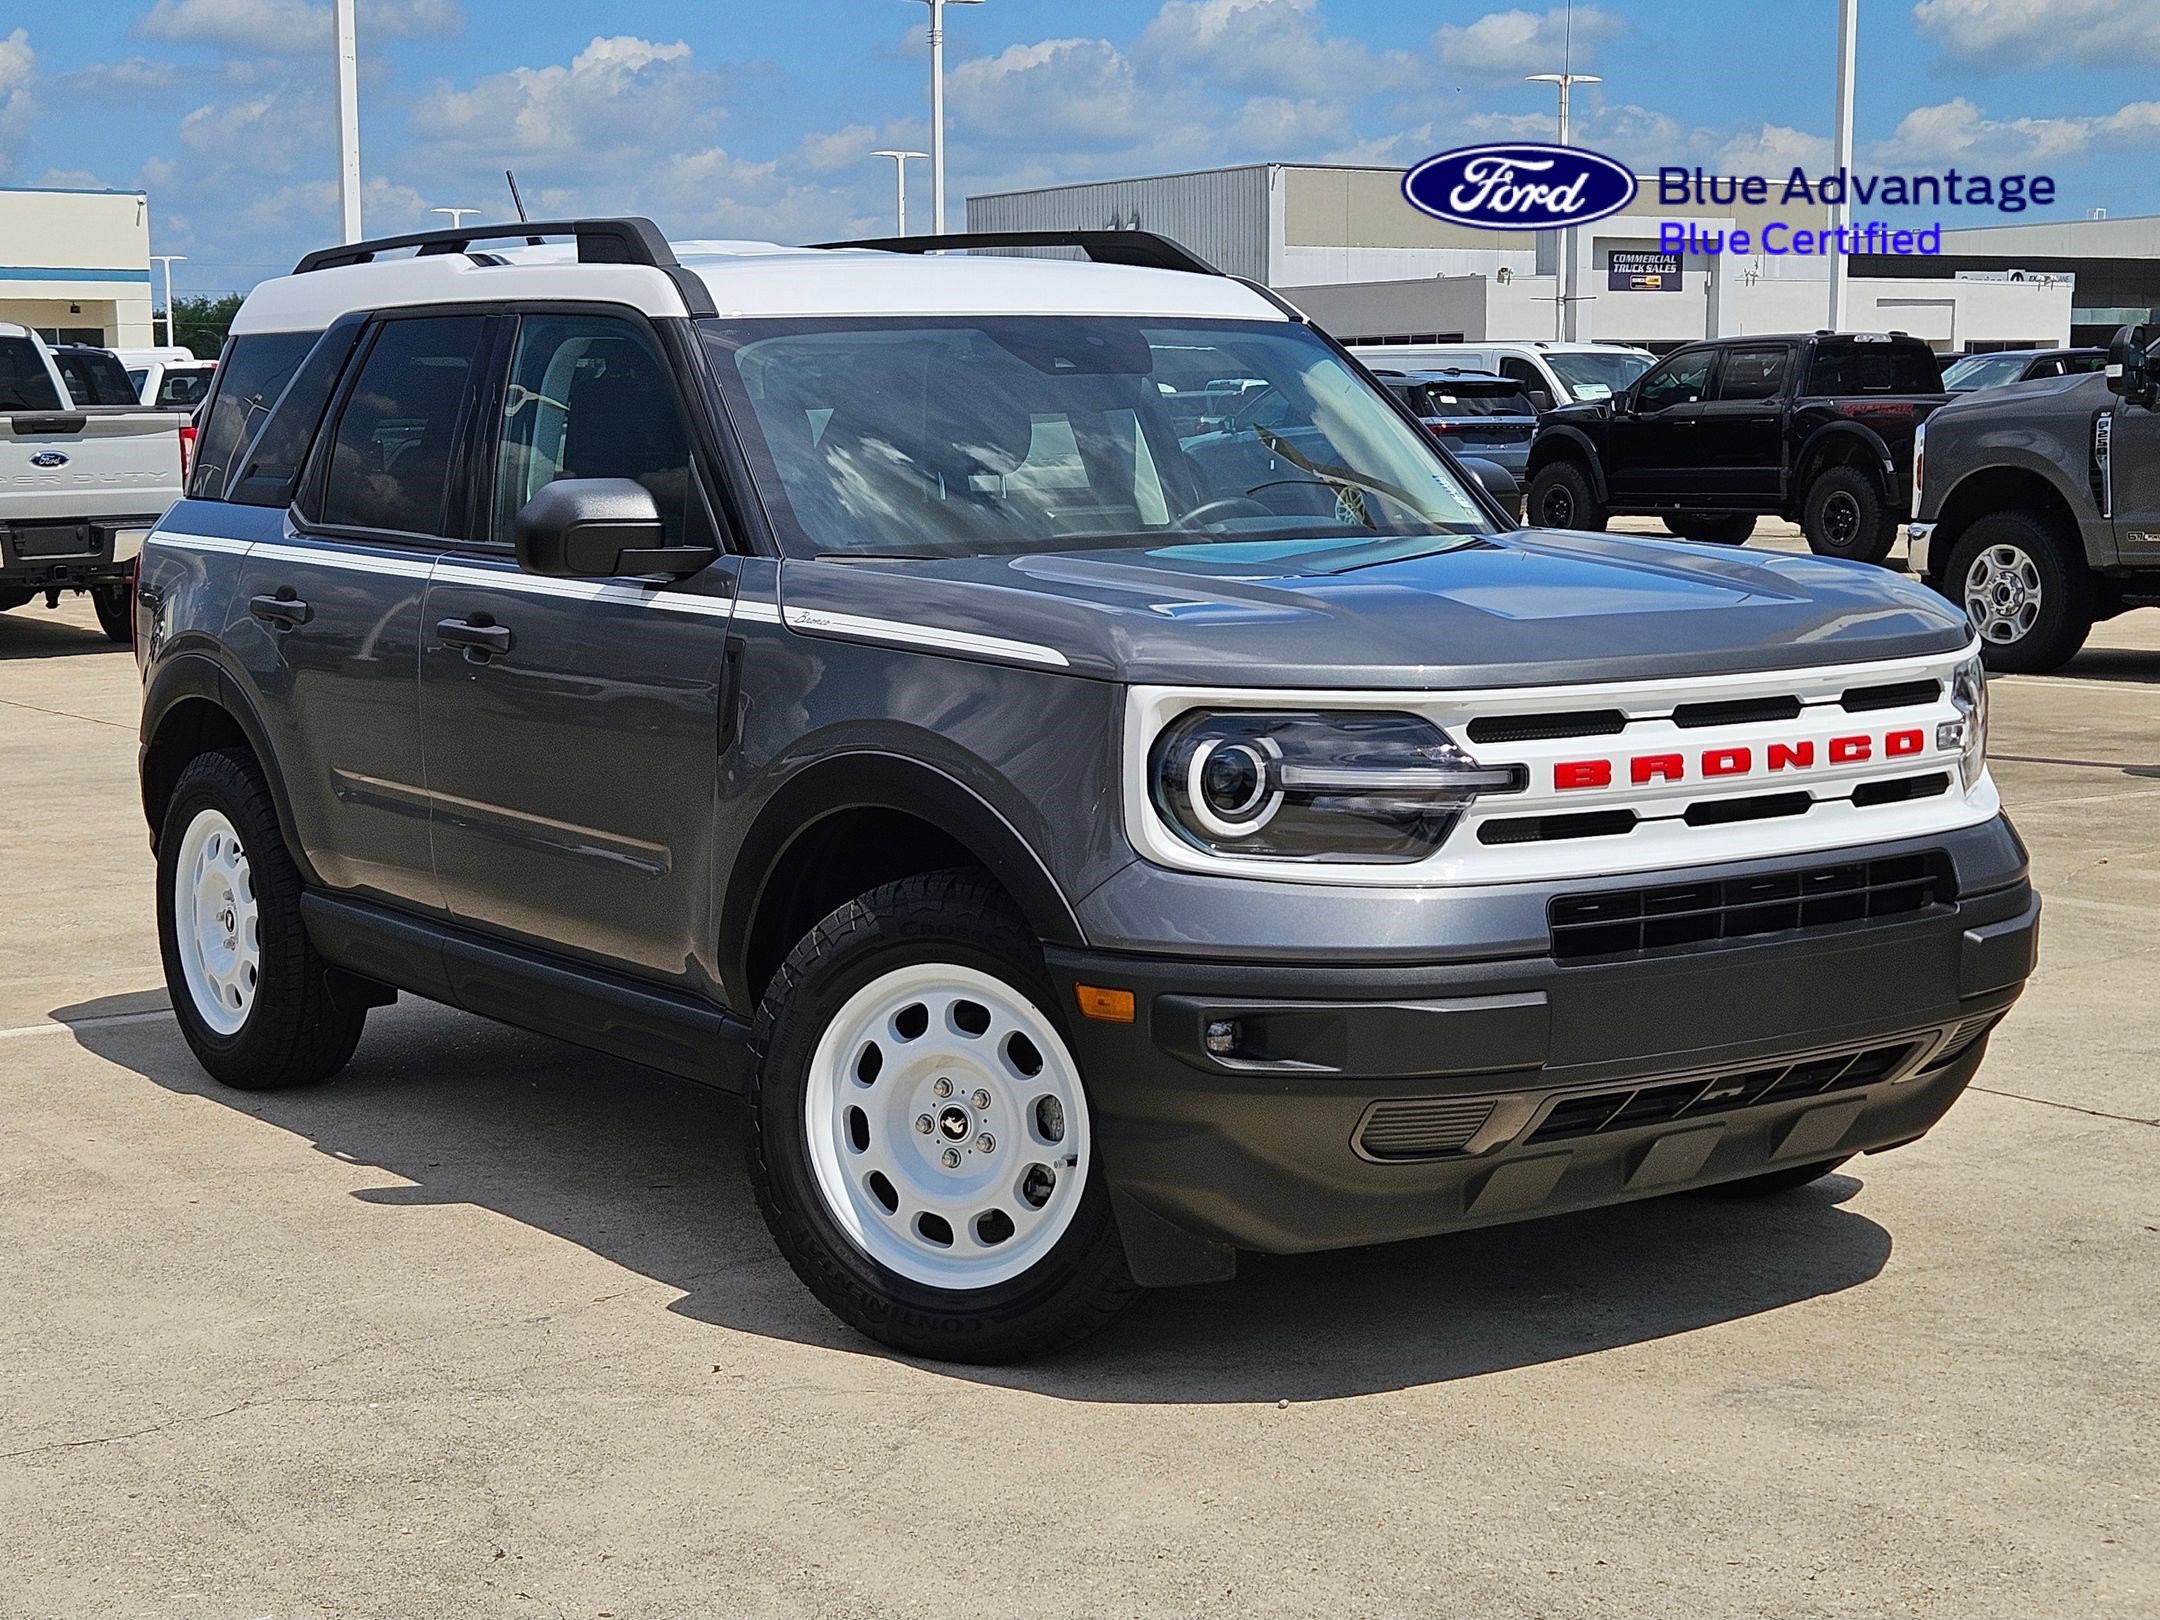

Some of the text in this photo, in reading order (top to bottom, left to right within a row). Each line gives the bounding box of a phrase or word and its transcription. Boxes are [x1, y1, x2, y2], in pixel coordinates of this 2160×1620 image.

[1613, 254, 1677, 264] COMMERCIAL
[1613, 264, 1677, 273] TRUCK SALES
[72, 471, 168, 484] DUTY
[794, 611, 831, 626] Bronco
[1554, 728, 1924, 792] BRONCO
